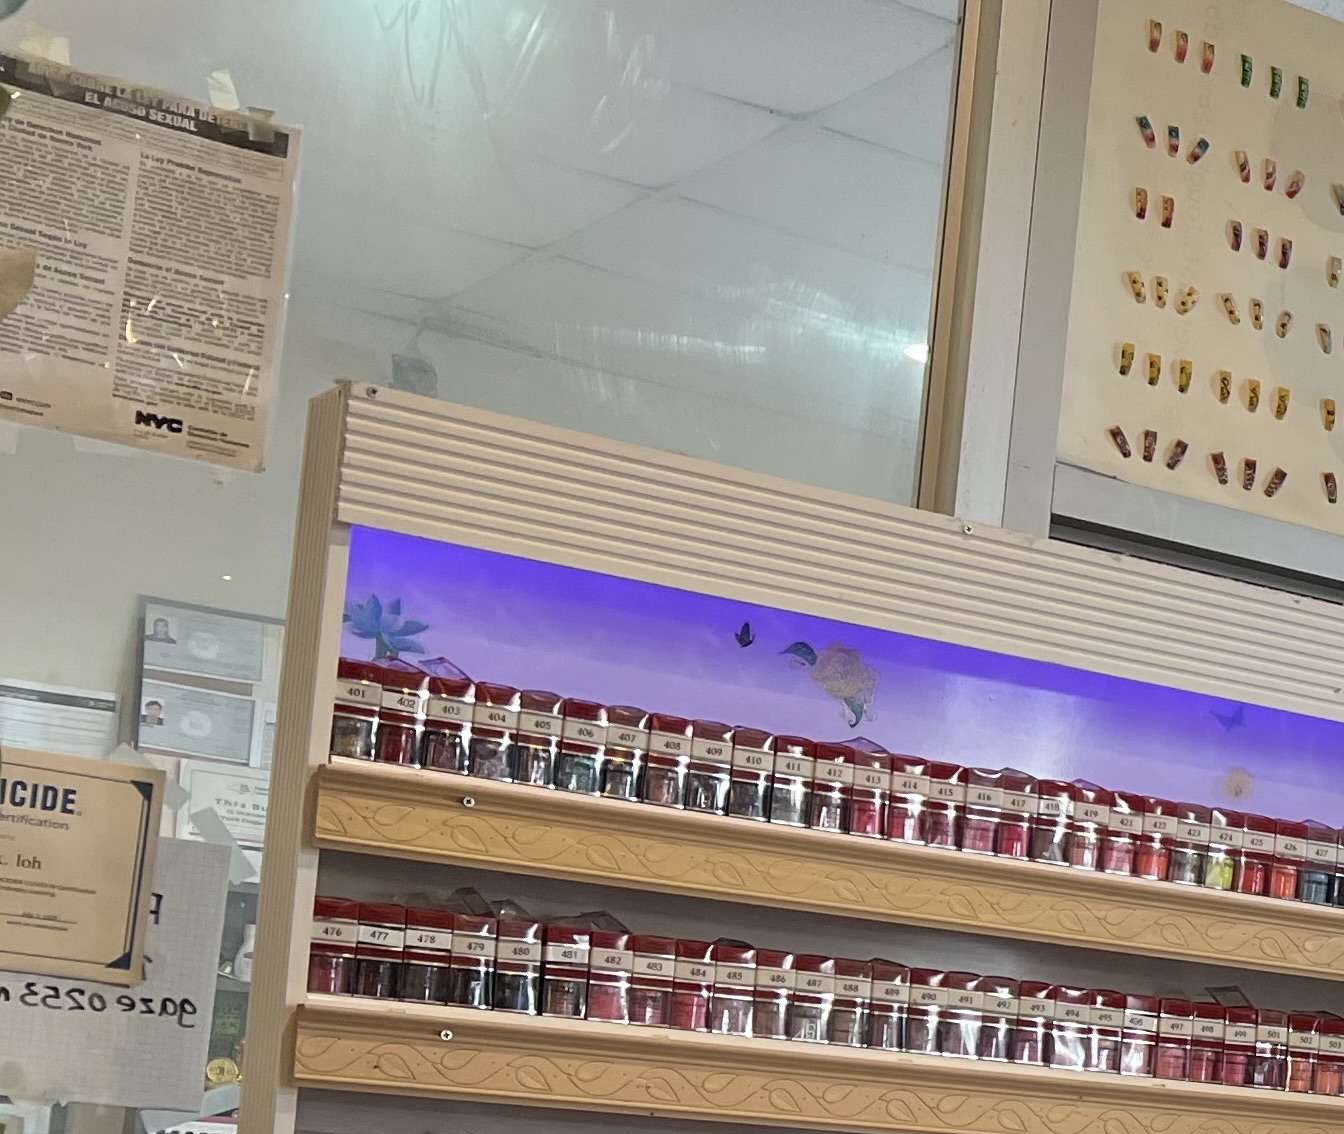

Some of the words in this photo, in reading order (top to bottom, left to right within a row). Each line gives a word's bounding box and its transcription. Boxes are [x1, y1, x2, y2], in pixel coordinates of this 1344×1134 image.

[84, 91, 101, 105] EL
[148, 109, 197, 132] SEXUAL
[135, 410, 183, 433] NYC
[346, 687, 365, 697] 401
[396, 697, 416, 708] 402
[441, 704, 460, 715] 403
[487, 711, 506, 723] 404
[533, 718, 551, 730] 405
[576, 727, 594, 737] 406
[618, 731, 636, 742] 407
[663, 740, 681, 751] 408
[705, 746, 723, 757] 409
[784, 760, 801, 771] 411
[1314, 847, 1328, 856] 427
[322, 926, 342, 935] 476
[369, 930, 389, 940] 477
[416, 934, 436, 944] 478
[466, 941, 485, 951] 479
[511, 946, 530, 956] 480
[560, 950, 578, 960] 481
[604, 955, 621, 965] 482
[805, 978, 822, 988] 487
[1170, 1022, 1184, 1031] 497
